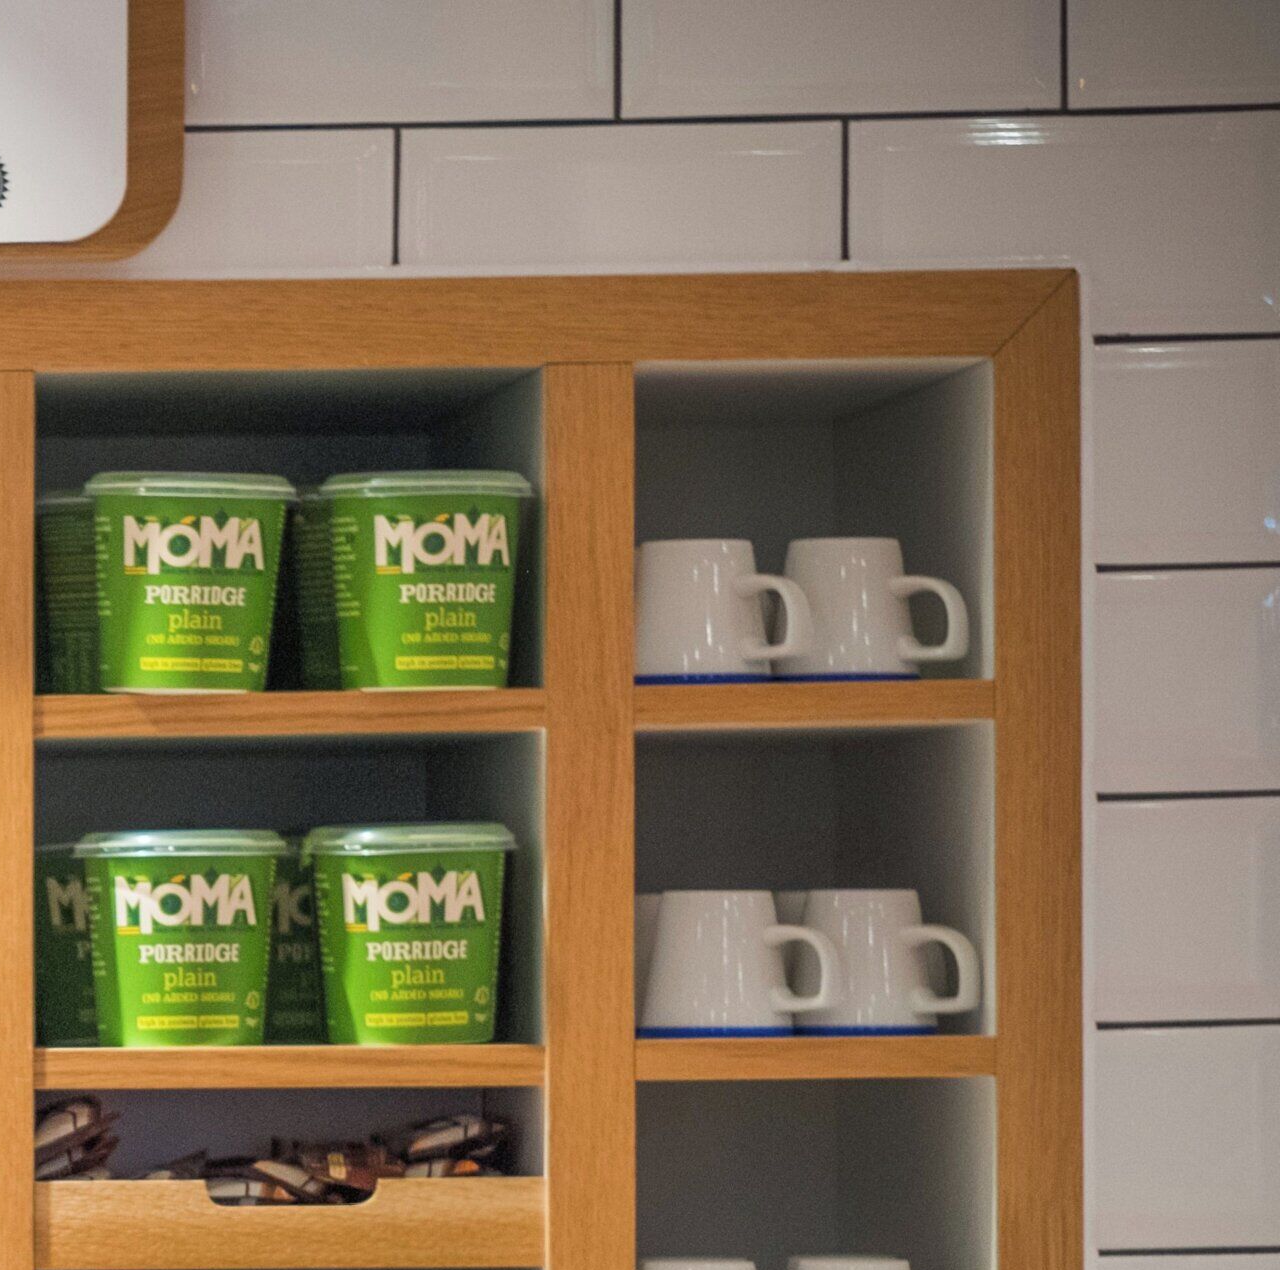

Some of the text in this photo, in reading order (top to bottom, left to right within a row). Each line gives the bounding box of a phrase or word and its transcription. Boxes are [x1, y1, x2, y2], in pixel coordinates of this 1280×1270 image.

[123, 515, 265, 575] MOMA
[373, 512, 510, 574] MOMA
[144, 584, 247, 607] PORRIDGE
[399, 582, 497, 604] PORRIDGE
[168, 609, 222, 632] plain
[425, 606, 477, 631] plain
[114, 873, 257, 935] MOMA
[341, 870, 486, 932] MOMA
[138, 943, 240, 964] PORRIDGE
[366, 939, 468, 961] PORRIDGE
[163, 967, 217, 991] plain
[391, 964, 445, 988] plain
